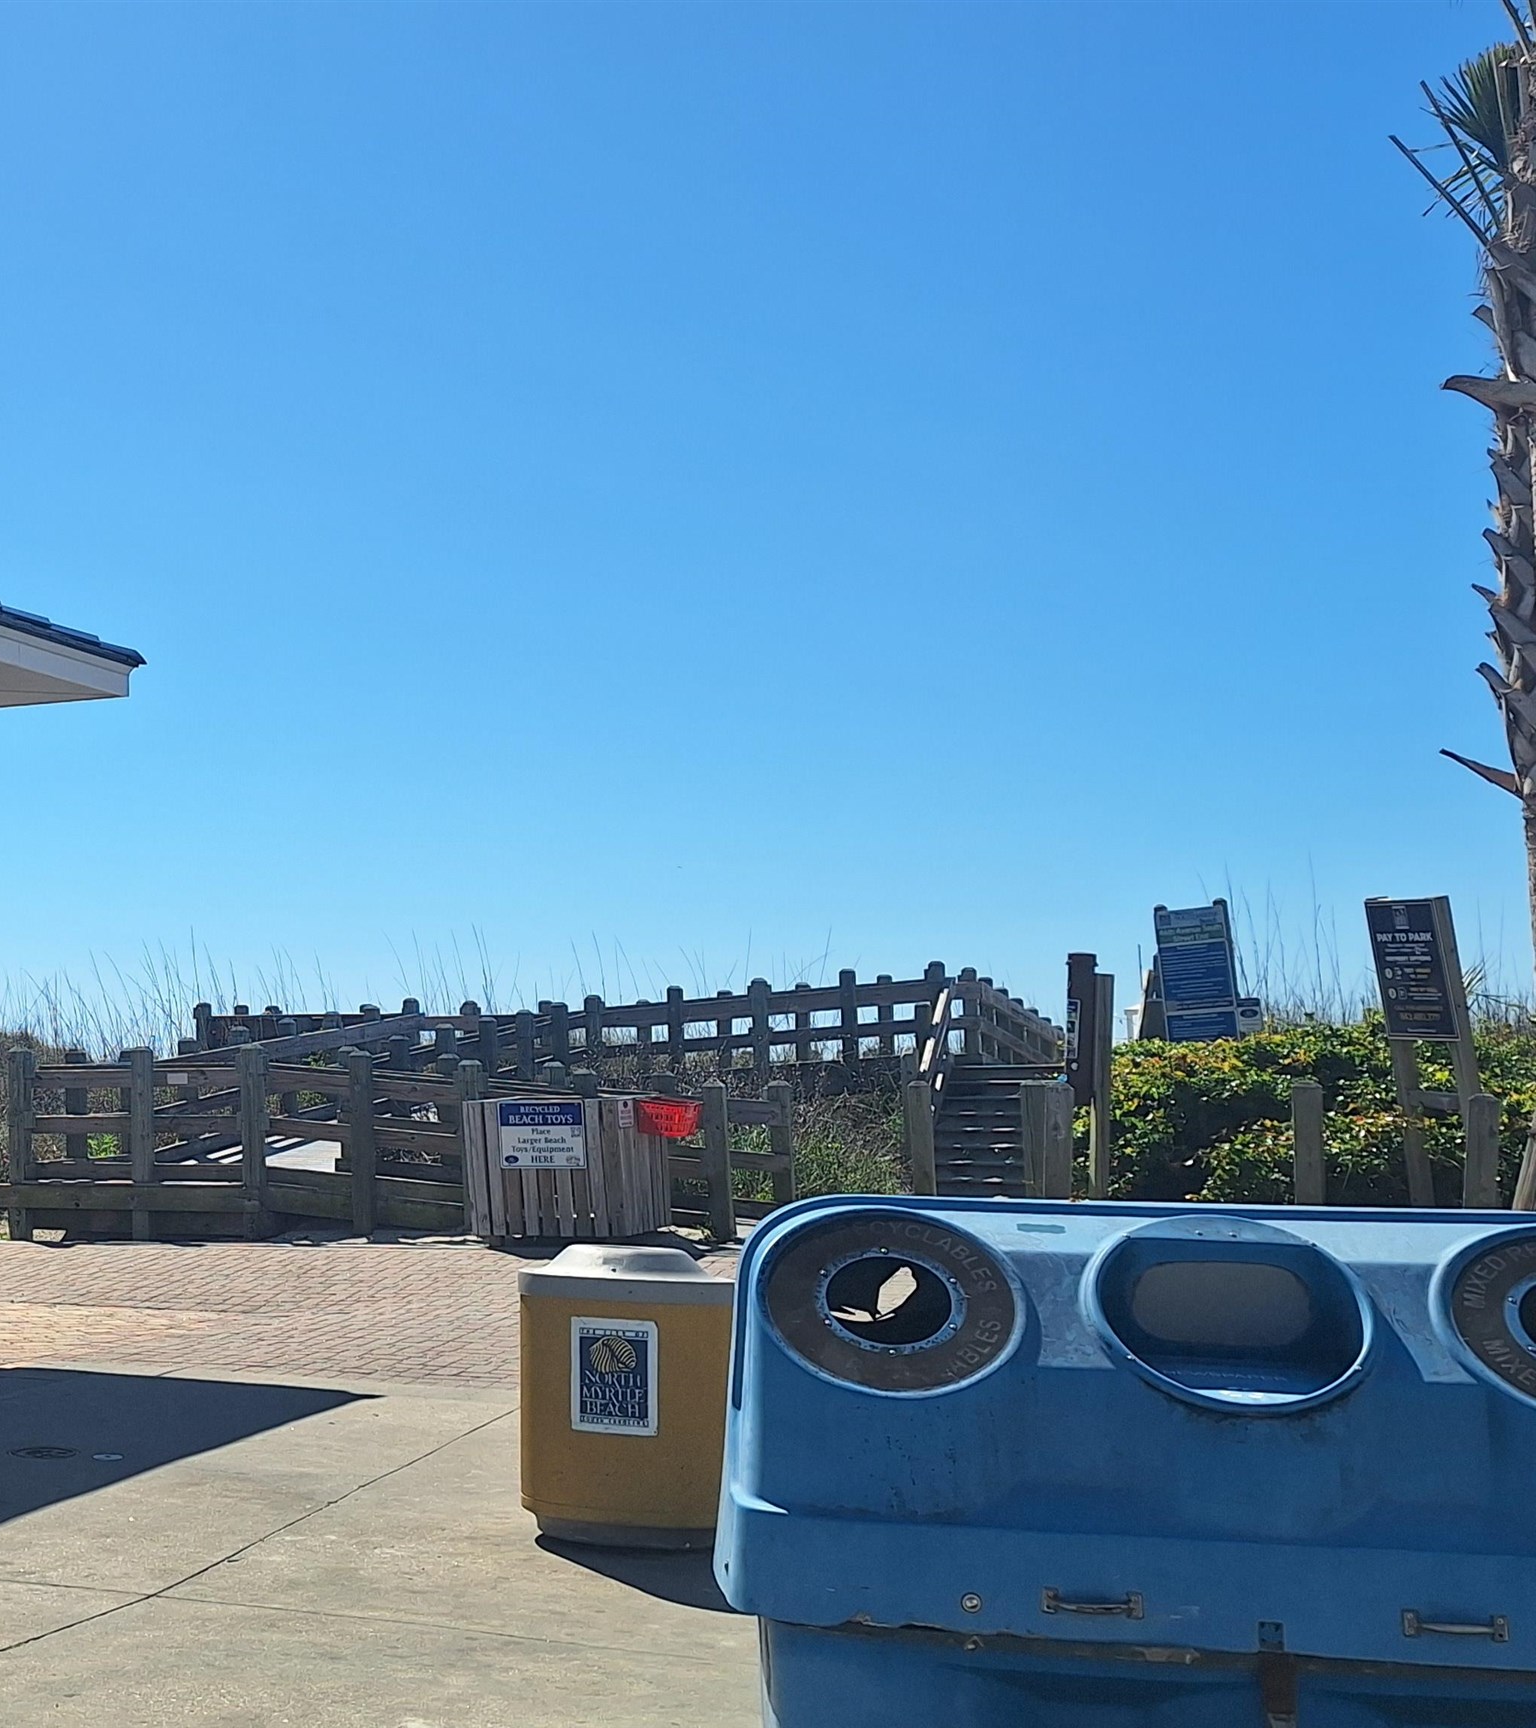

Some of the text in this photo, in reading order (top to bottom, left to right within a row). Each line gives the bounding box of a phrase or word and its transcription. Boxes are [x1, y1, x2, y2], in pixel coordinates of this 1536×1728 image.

[1376, 931, 1433, 942] PAY TO PARK
[519, 1105, 561, 1114] RECYCLED
[508, 1114, 574, 1124] BEACH TOYS
[531, 1127, 551, 1135] Place
[517, 1136, 567, 1145] Larger Beach
[511, 1145, 574, 1154] Toys/Equipment
[531, 1155, 556, 1164] HERE
[1463, 1255, 1507, 1309] MIXED
[1482, 1338, 1536, 1386] MIXE
[584, 1370, 641, 1387] NORTH
[582, 1385, 645, 1402] MYRTLE
[586, 1400, 640, 1417] BEACH
